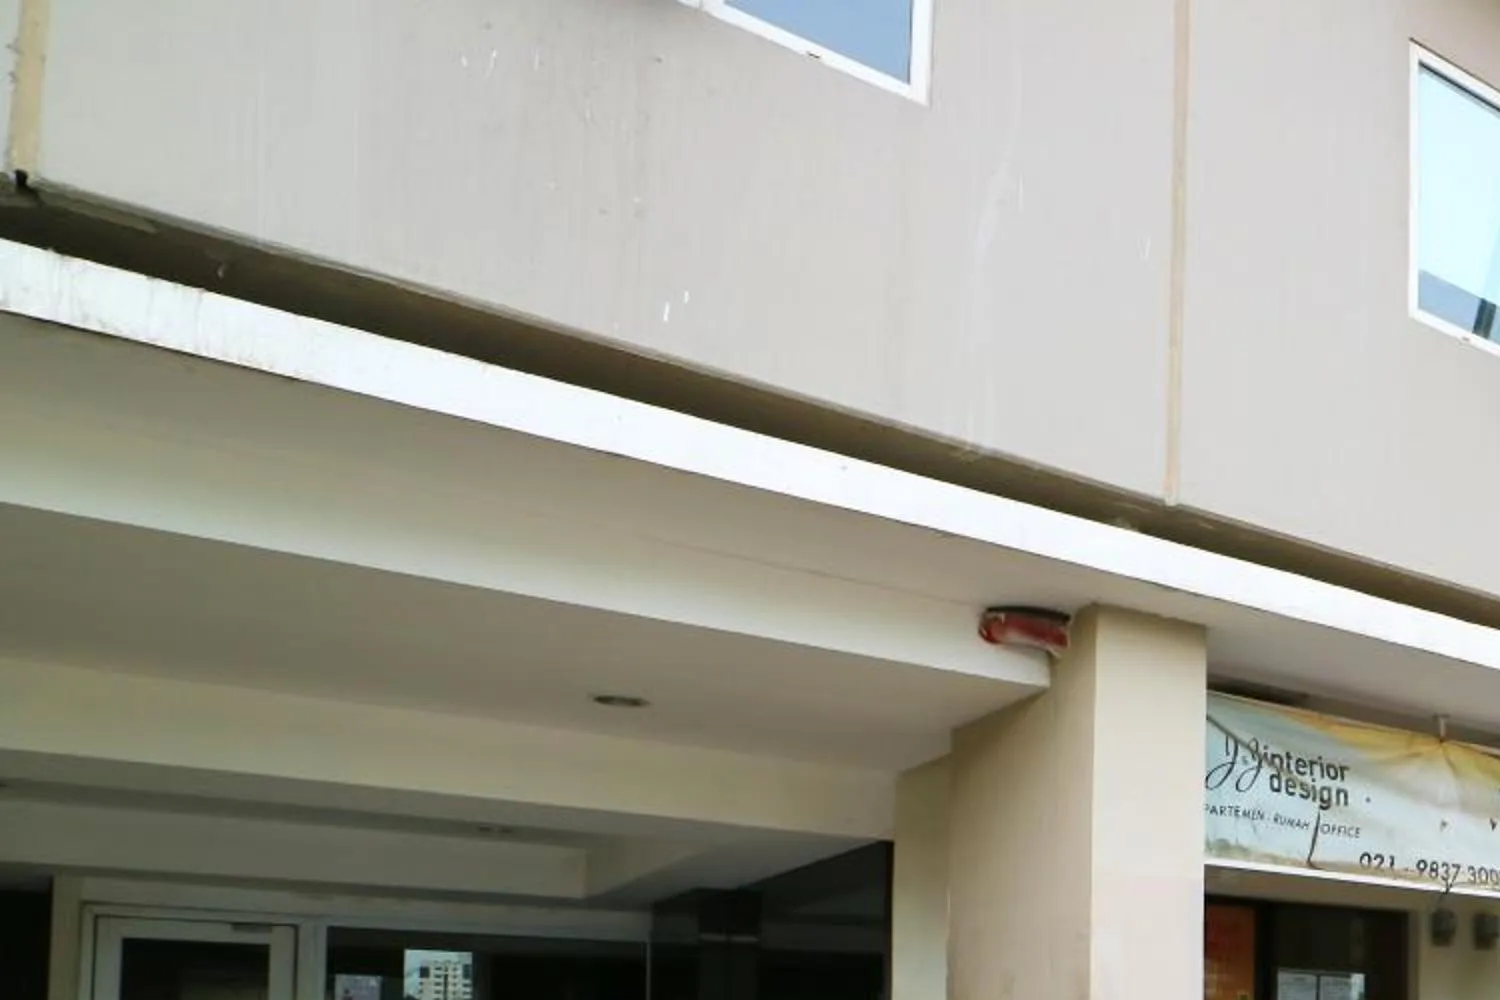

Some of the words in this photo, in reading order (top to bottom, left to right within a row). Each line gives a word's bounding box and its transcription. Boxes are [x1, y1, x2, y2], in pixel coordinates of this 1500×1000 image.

[1262, 744, 1351, 782] interior
[1269, 770, 1349, 811] design
[1273, 813, 1310, 830] RUMAH
[1319, 823, 1361, 839] OFFICE
[1359, 851, 1395, 872] 021
[1416, 859, 1461, 885] 9837
